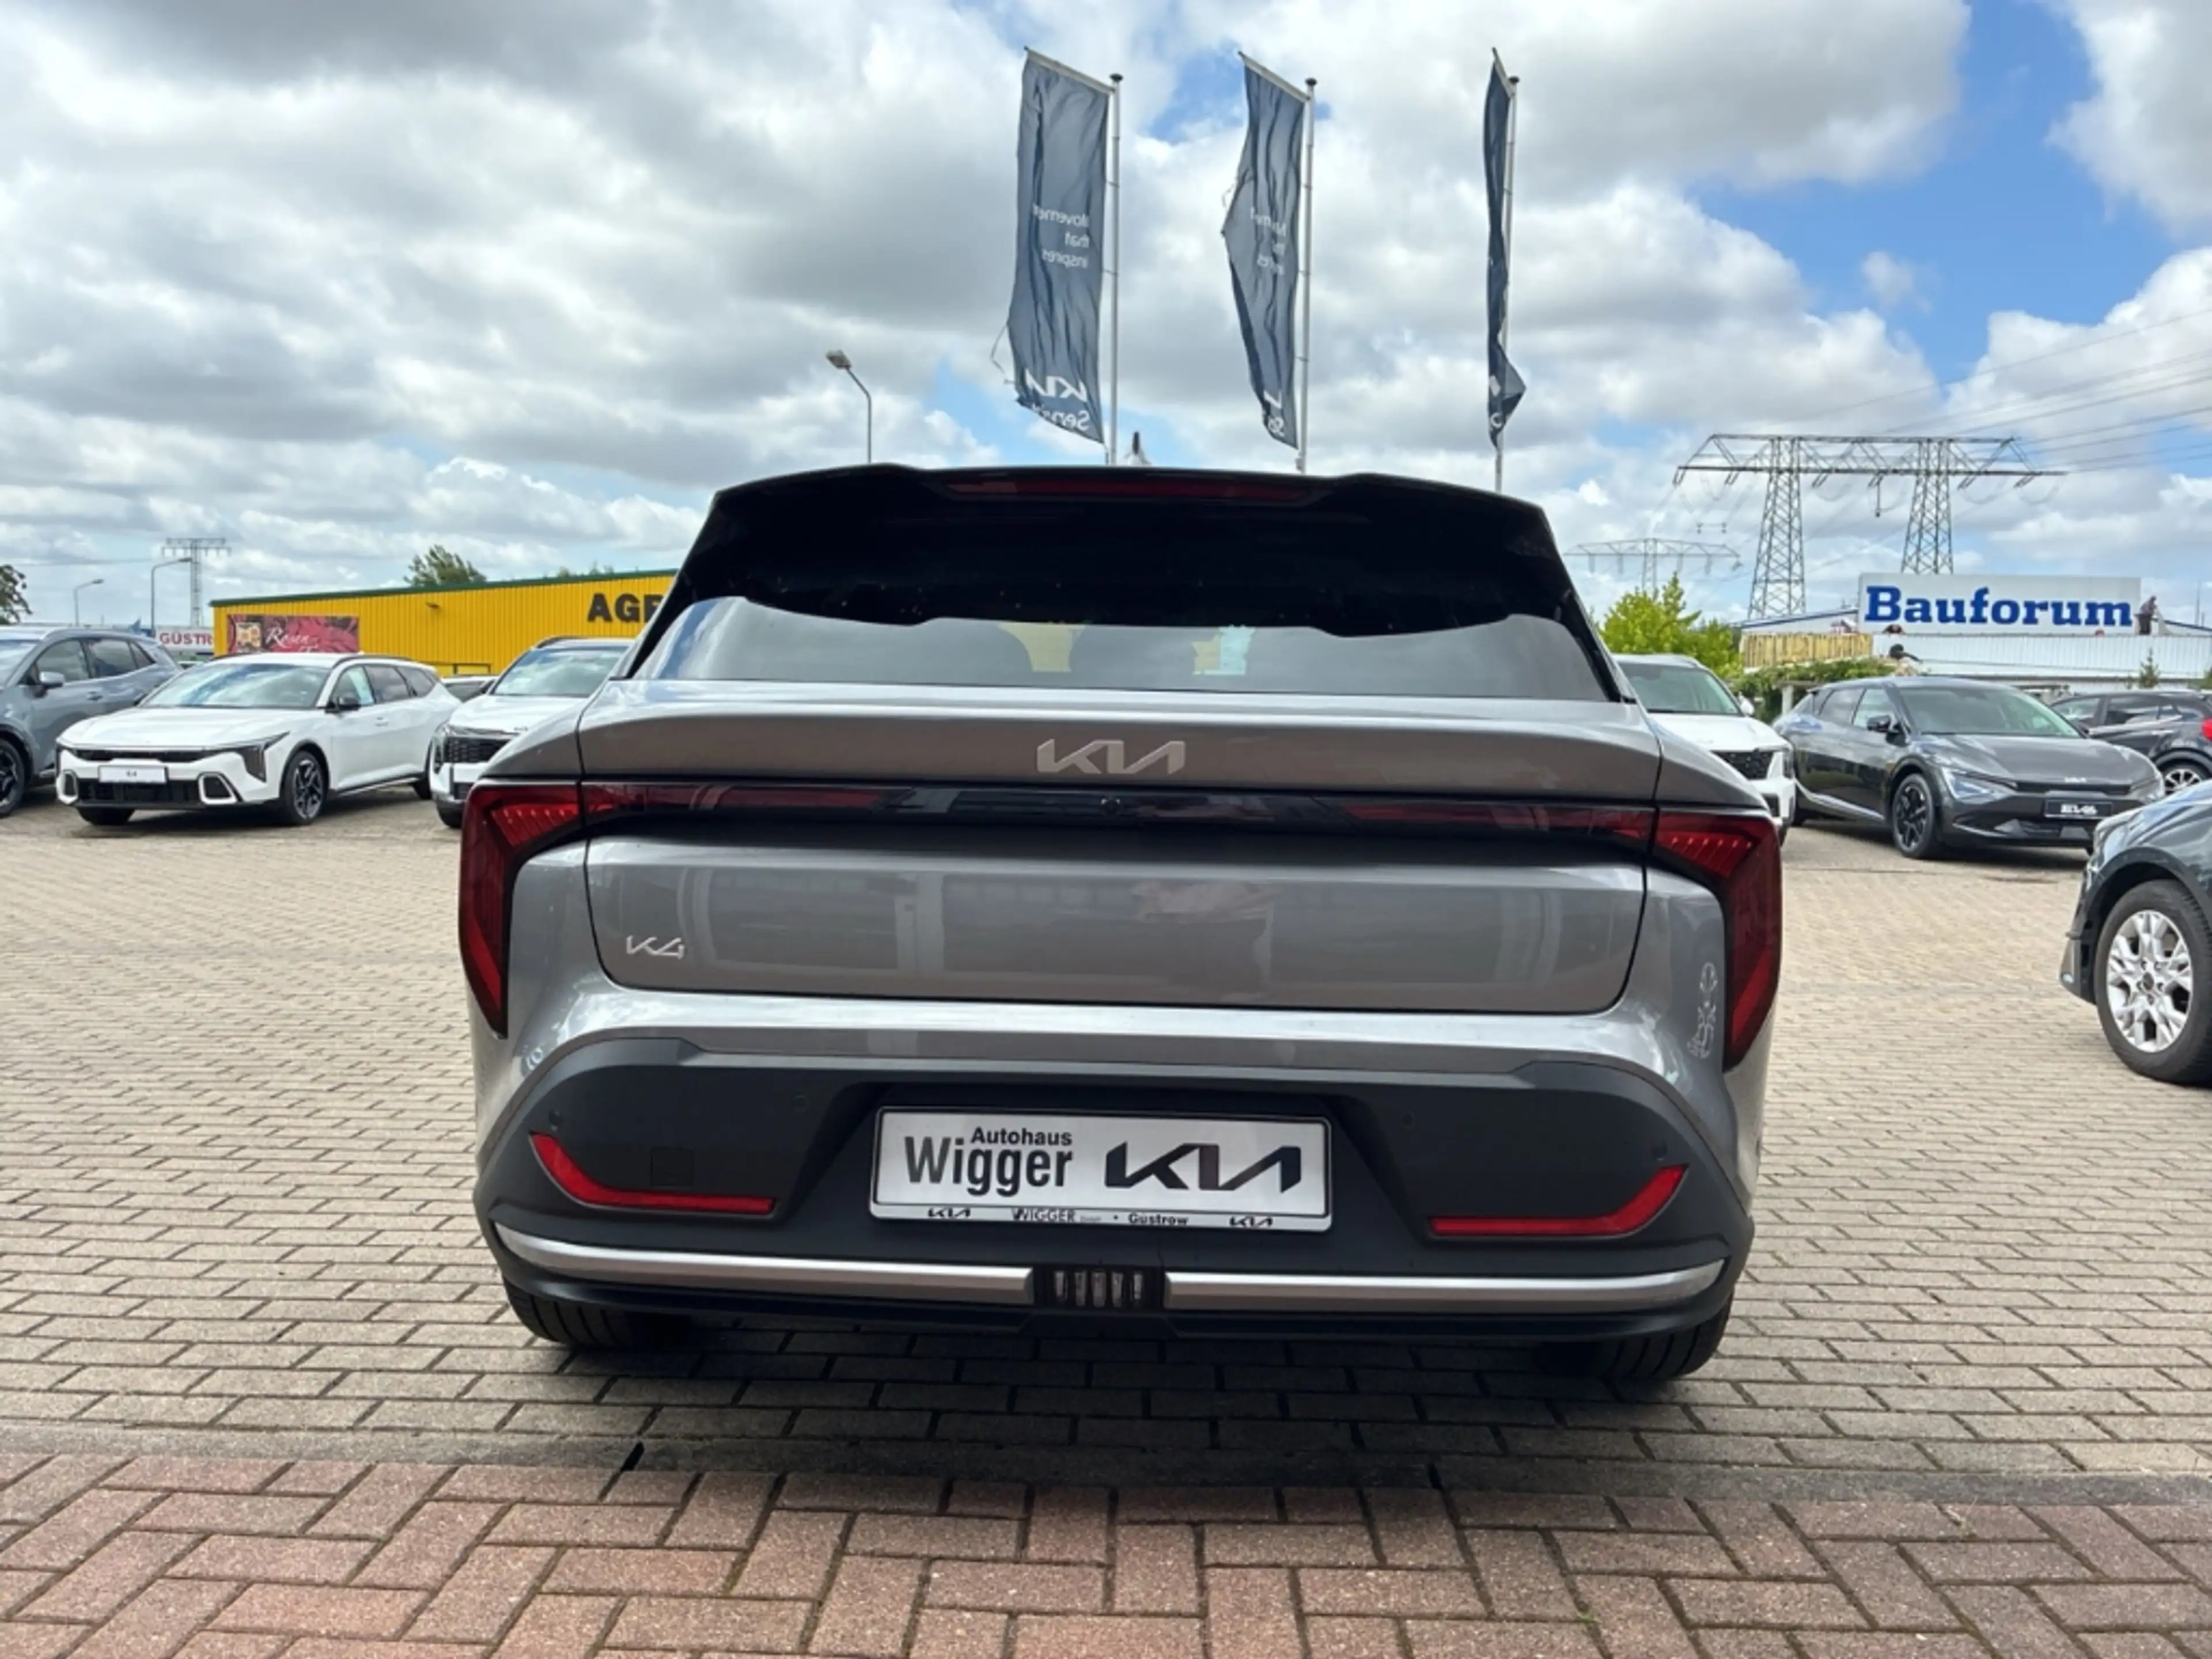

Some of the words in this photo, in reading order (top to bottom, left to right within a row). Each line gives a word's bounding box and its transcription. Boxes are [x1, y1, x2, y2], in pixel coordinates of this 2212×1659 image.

[1863, 585, 2133, 627] Bauforum
[1037, 738, 1185, 774] KIA
[970, 1126, 1072, 1146] Autohaus
[904, 1136, 1073, 1198] Wigger
[1104, 1141, 1301, 1194] KIA
[1011, 1207, 1076, 1222] WIGGER
